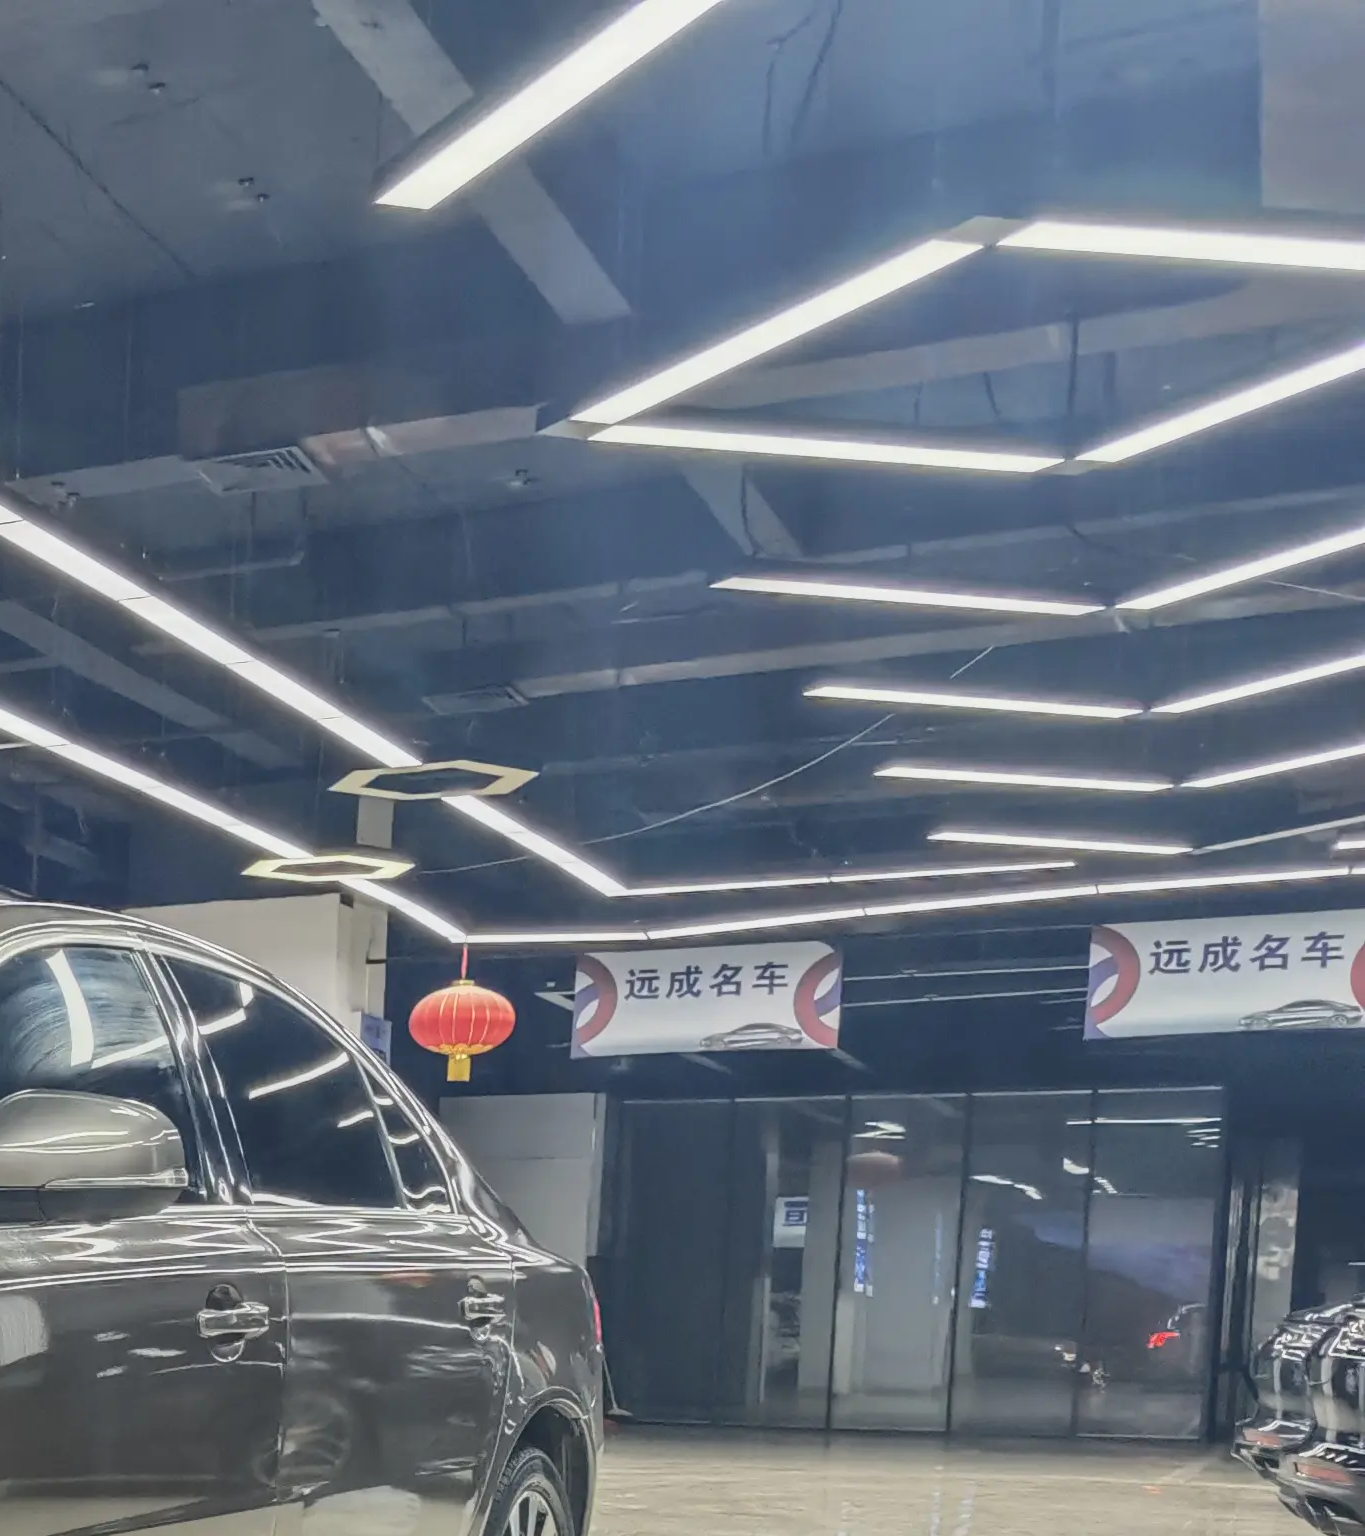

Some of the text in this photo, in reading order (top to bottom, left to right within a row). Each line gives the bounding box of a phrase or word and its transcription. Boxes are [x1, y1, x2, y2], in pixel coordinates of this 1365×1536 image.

[1148, 931, 1345, 975] 远成名车
[624, 961, 789, 1000] 远成名车
